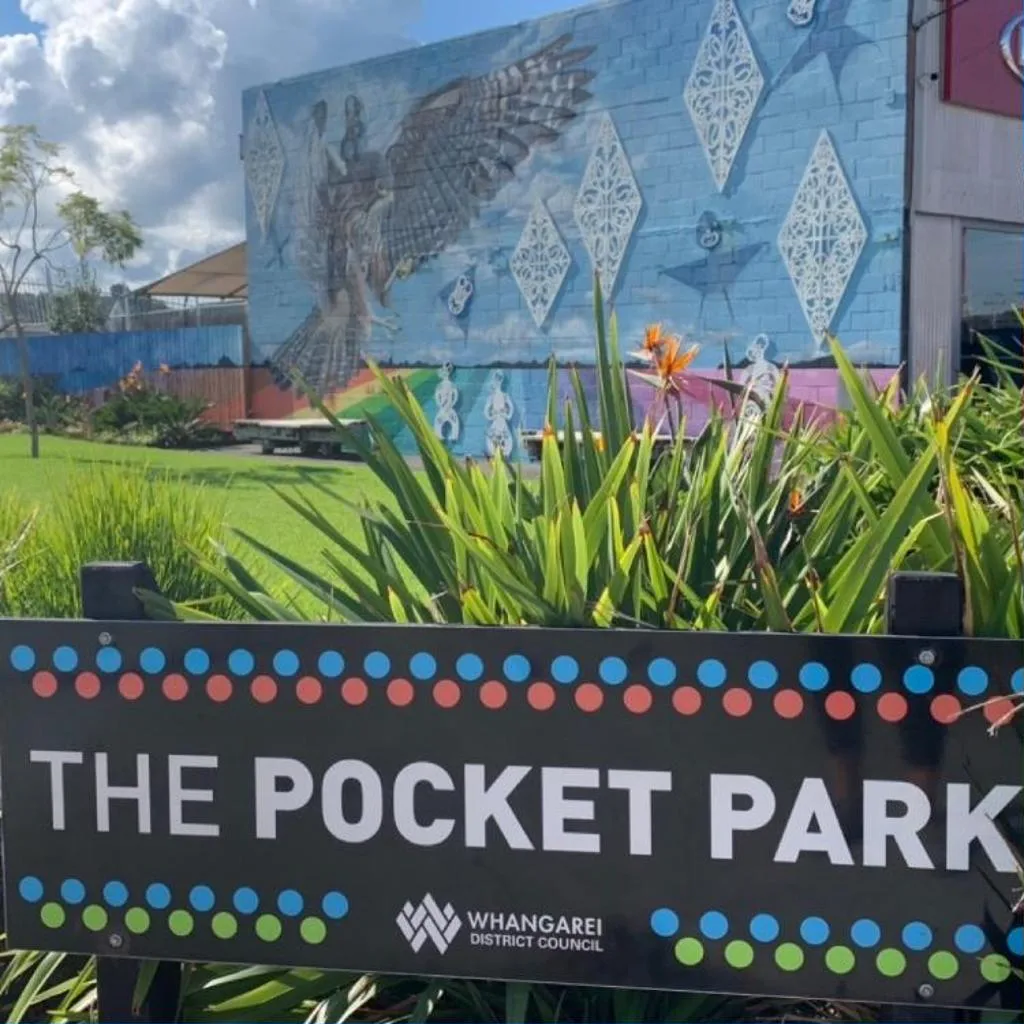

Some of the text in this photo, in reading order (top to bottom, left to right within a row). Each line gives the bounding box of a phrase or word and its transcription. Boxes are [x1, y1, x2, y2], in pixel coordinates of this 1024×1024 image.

[30, 750, 1023, 872] THE POCKET PARK
[468, 911, 602, 936] WHANGAREI
[470, 933, 603, 952] DISTRICT COUNCIL
